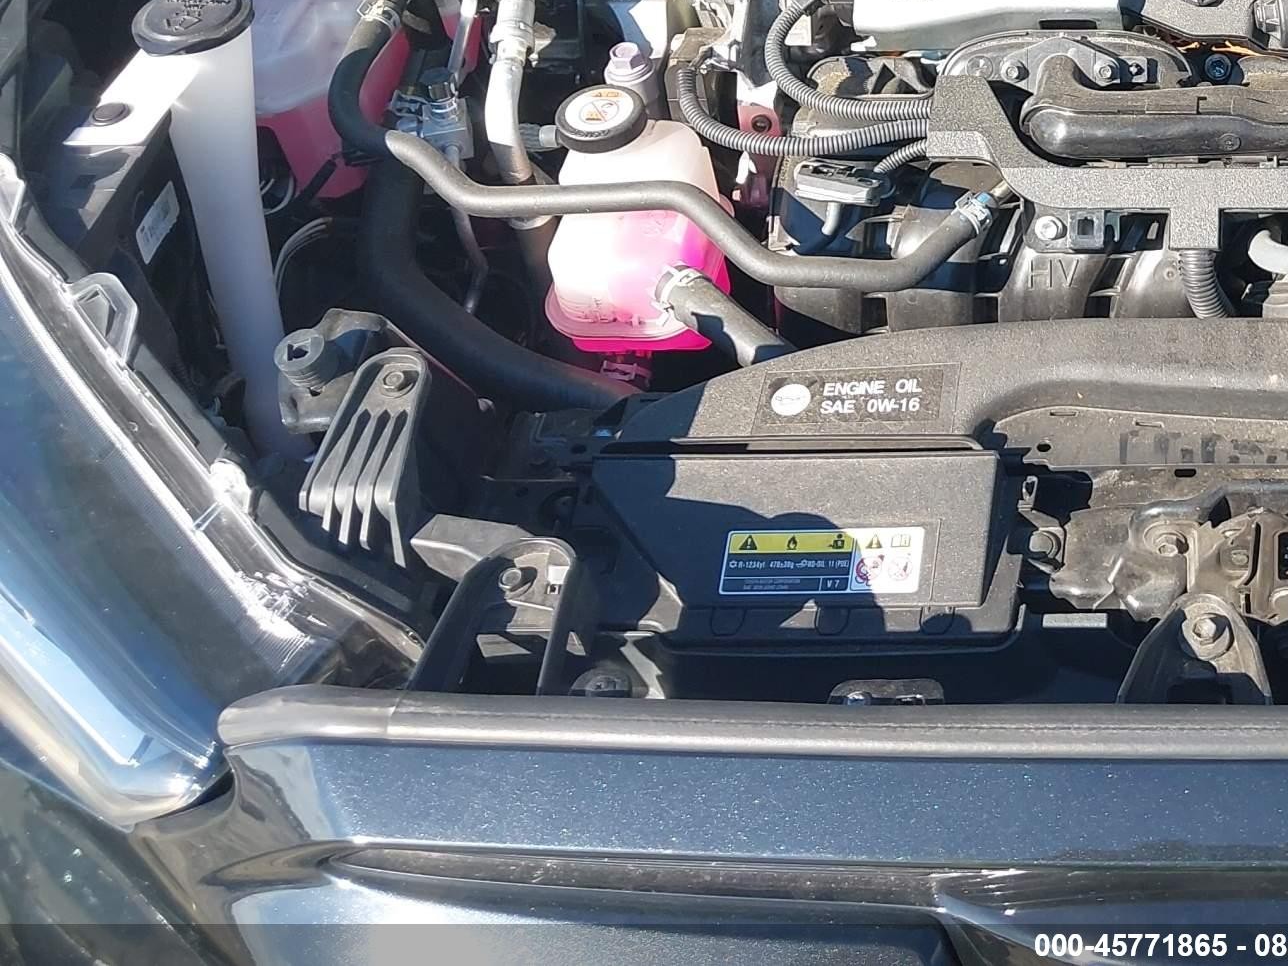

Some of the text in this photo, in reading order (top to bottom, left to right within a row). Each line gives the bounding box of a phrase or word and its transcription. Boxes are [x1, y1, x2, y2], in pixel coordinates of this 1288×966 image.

[1028, 259, 1080, 289] HV
[823, 378, 923, 396] ENGINE OIL
[820, 397, 921, 414] SAE 0W-16
